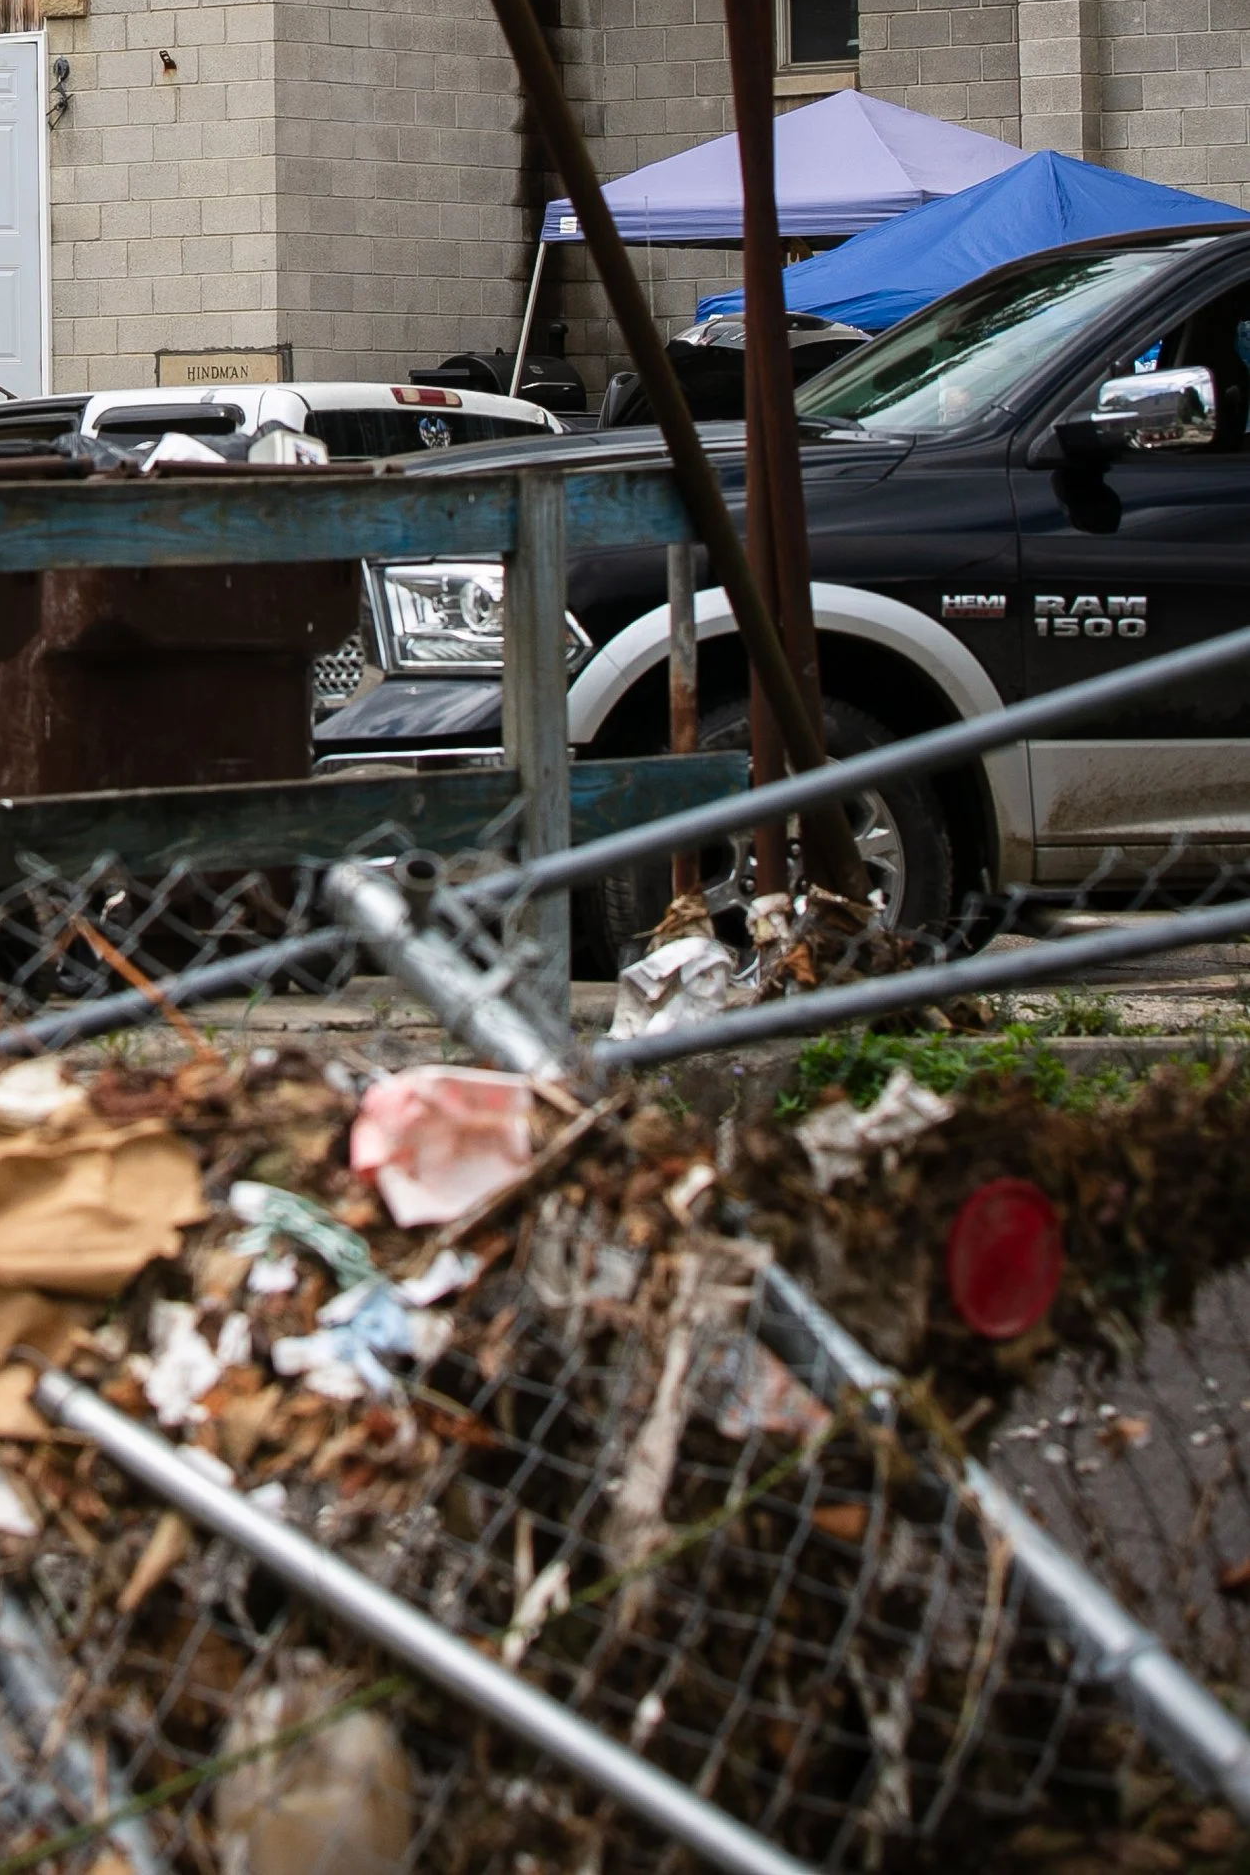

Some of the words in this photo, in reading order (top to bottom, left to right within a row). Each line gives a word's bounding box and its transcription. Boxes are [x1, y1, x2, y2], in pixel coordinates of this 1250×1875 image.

[187, 365, 249, 381] HINDMAN
[942, 595, 1006, 608] HEMI
[1034, 595, 1148, 616] RAM
[1034, 617, 1147, 637] 1500
